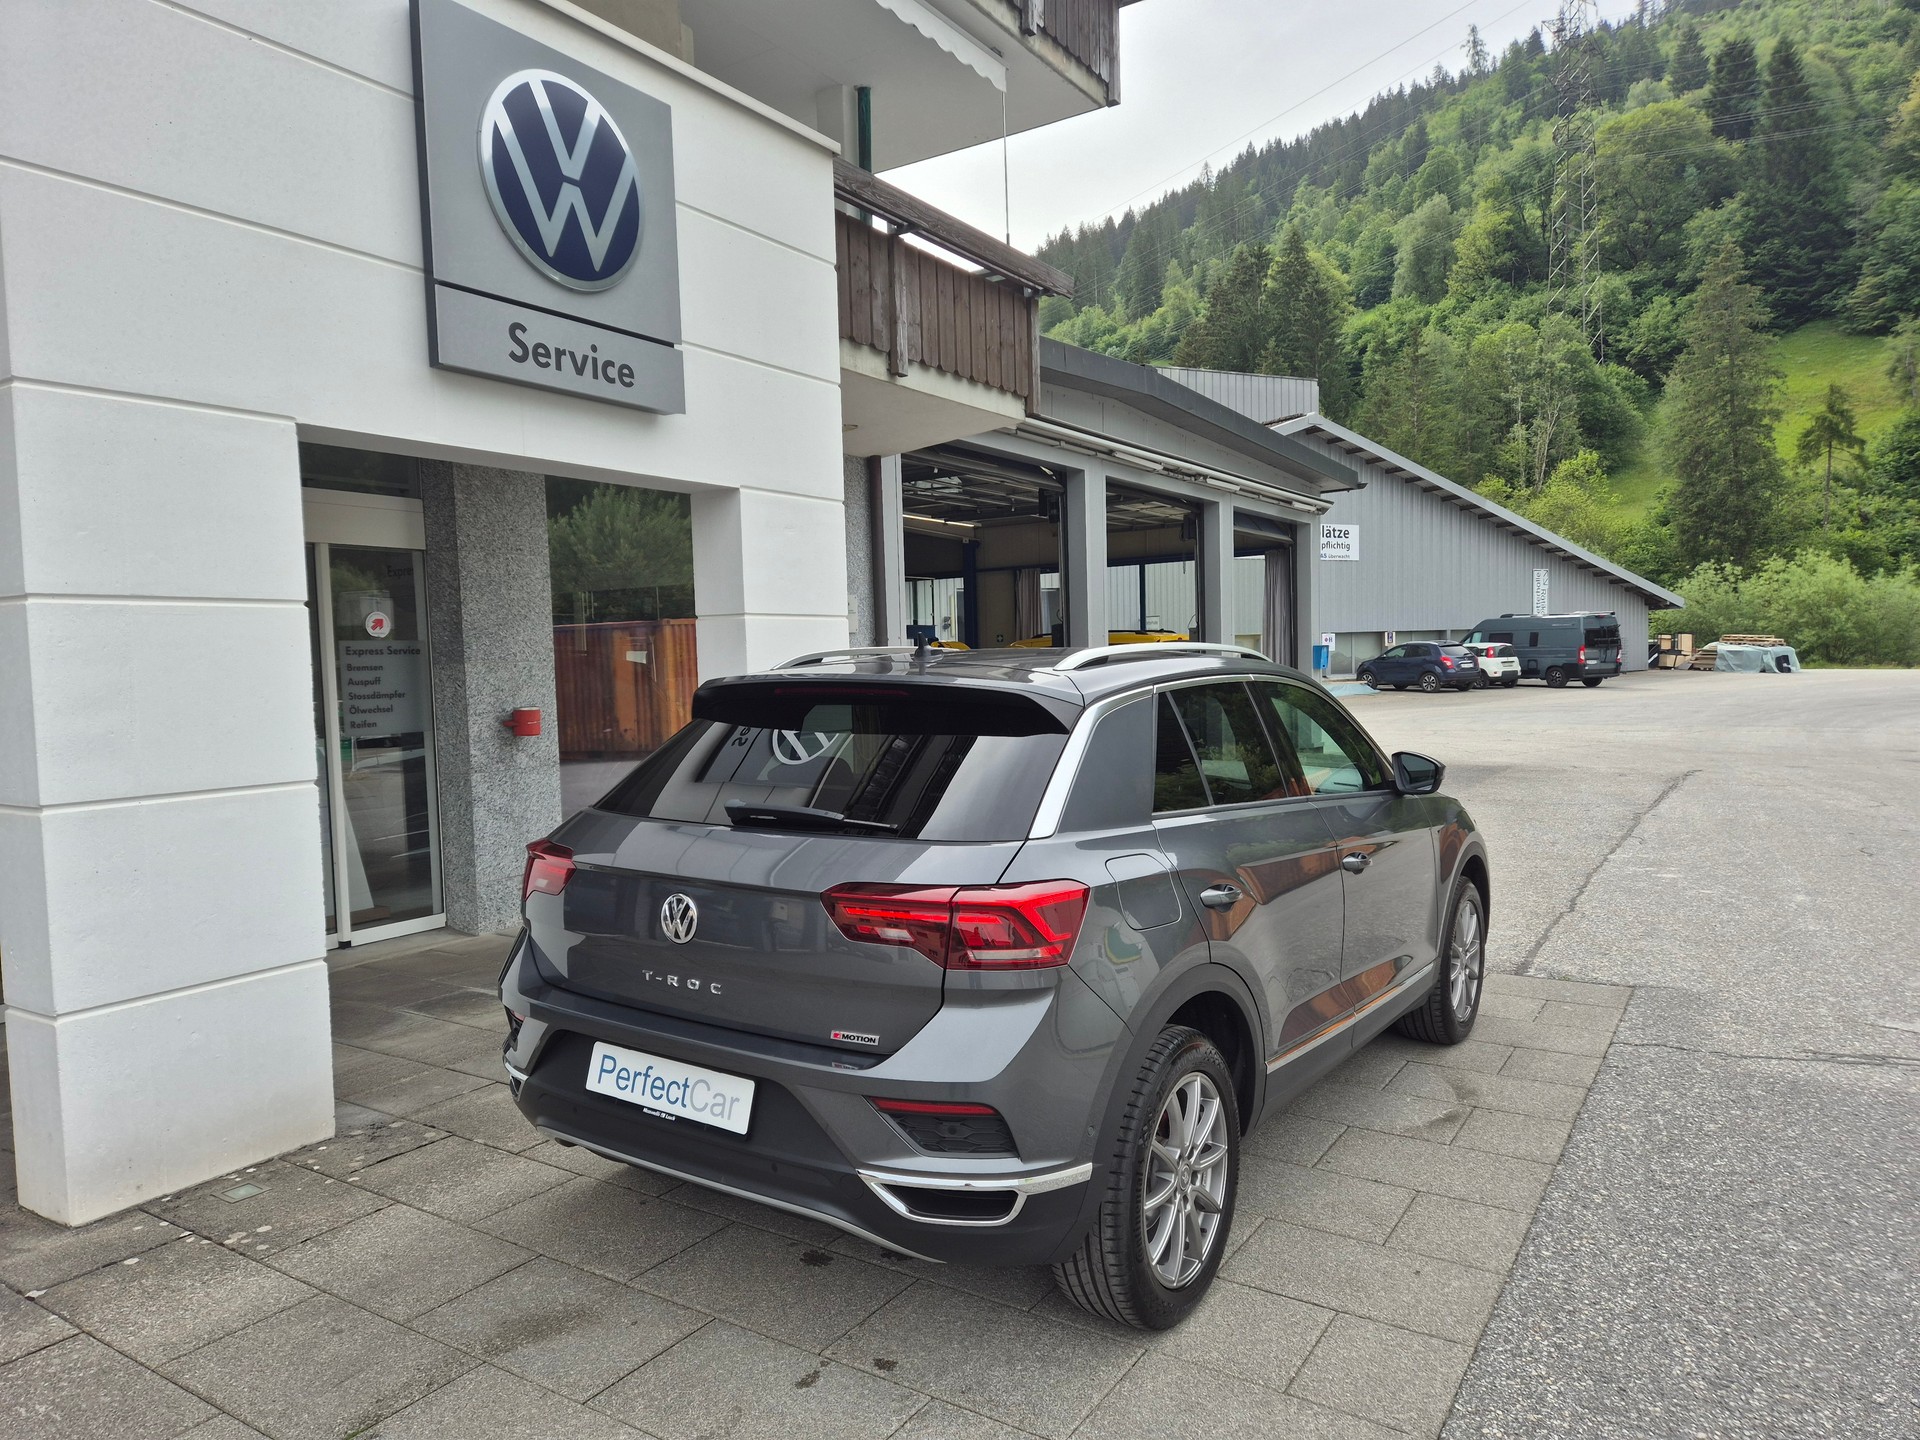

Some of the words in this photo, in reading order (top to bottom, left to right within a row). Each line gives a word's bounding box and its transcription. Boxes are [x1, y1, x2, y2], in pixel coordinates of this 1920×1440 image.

[508, 322, 635, 388] Service
[1322, 525, 1350, 539] lätze
[1321, 541, 1351, 551] pflichtig
[345, 646, 384, 658] Express
[386, 645, 421, 655] Service
[346, 663, 384, 672] Bremsen
[347, 676, 382, 687] Auspuff
[348, 690, 406, 701] Stossdämpfer
[349, 704, 394, 715] Ölwechsel
[350, 719, 378, 729] Reifen
[642, 970, 722, 994] T-ROC
[597, 1053, 740, 1121] PerfectCar
